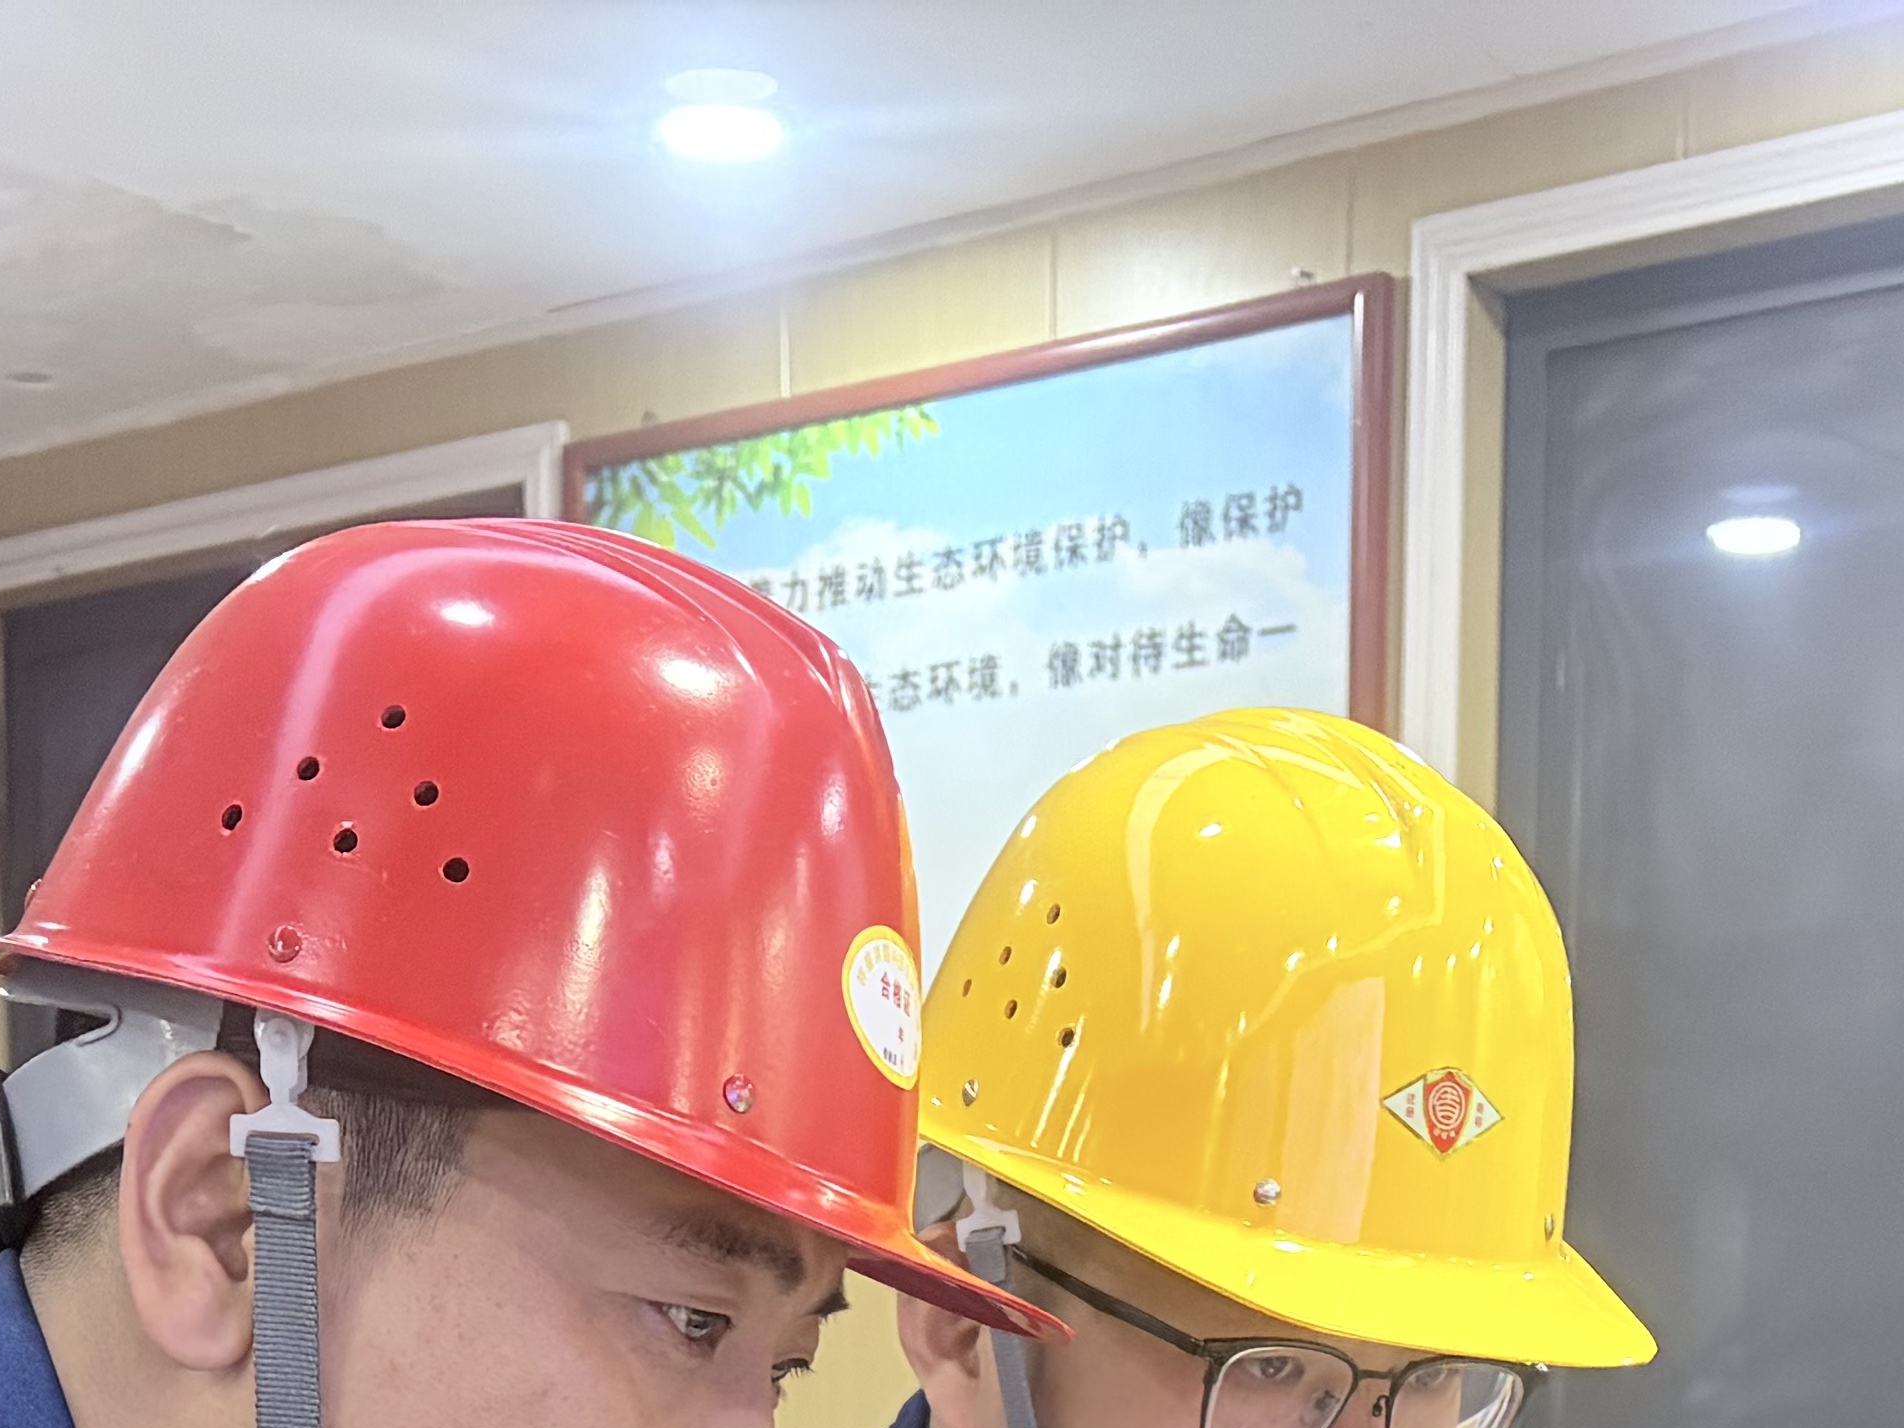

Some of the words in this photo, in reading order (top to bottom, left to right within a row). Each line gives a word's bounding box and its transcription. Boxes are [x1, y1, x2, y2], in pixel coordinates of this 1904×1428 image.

[865, 612, 1297, 713] 态环境，像对待生命一
